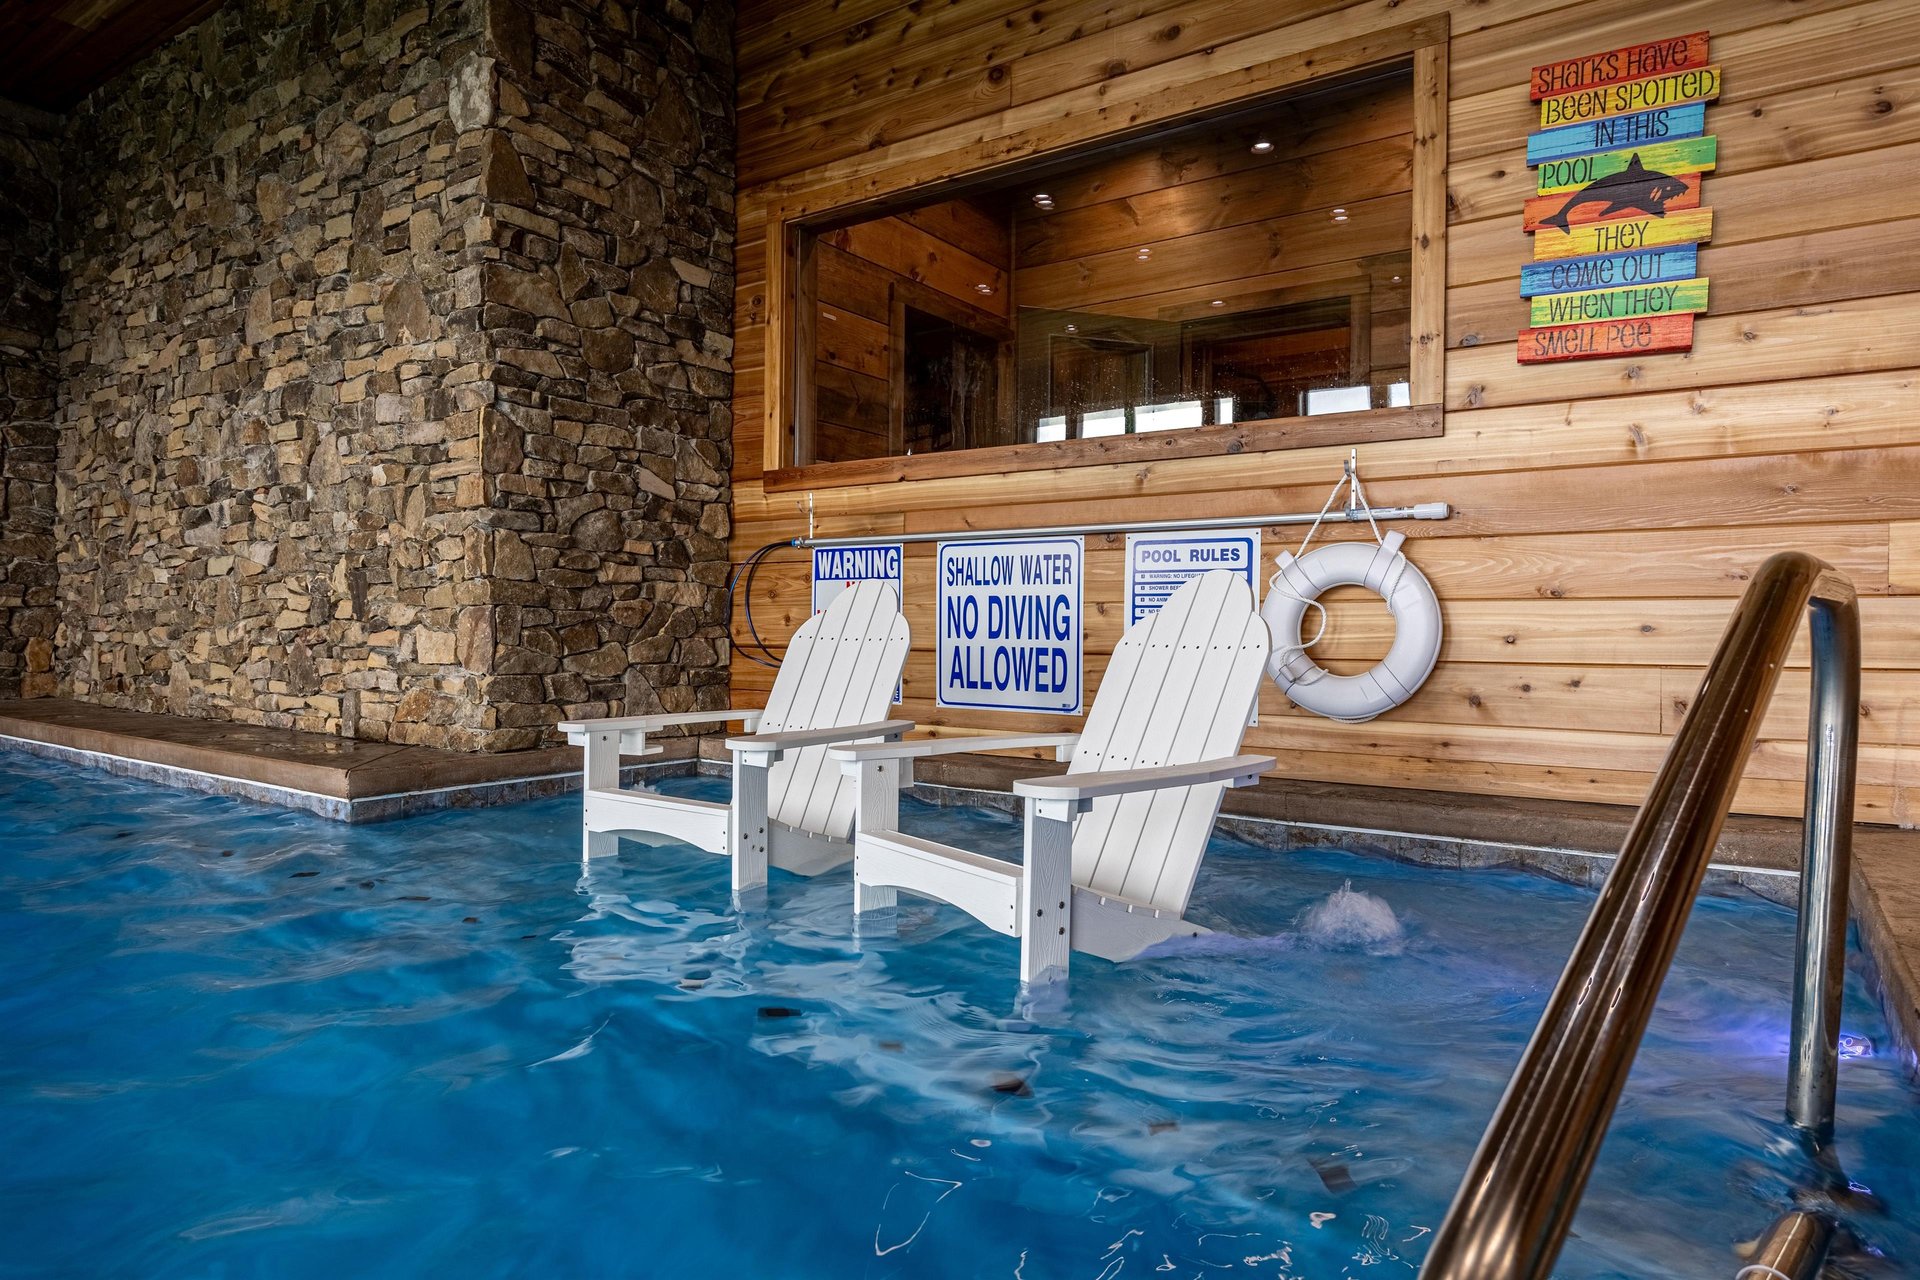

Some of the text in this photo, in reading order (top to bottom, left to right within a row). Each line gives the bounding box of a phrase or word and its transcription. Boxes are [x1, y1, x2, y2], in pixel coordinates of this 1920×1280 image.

[1595, 110, 1669, 147] IN THIS
[1542, 156, 1598, 189] POOL
[1622, 252, 1665, 281] OUT
[817, 548, 899, 579] WARNING
[946, 553, 1072, 586] SHALLOW WATER
[1141, 548, 1241, 563] POOL RULES
[947, 594, 1071, 641] NO DIVING
[949, 645, 1068, 693] ALLOWED
